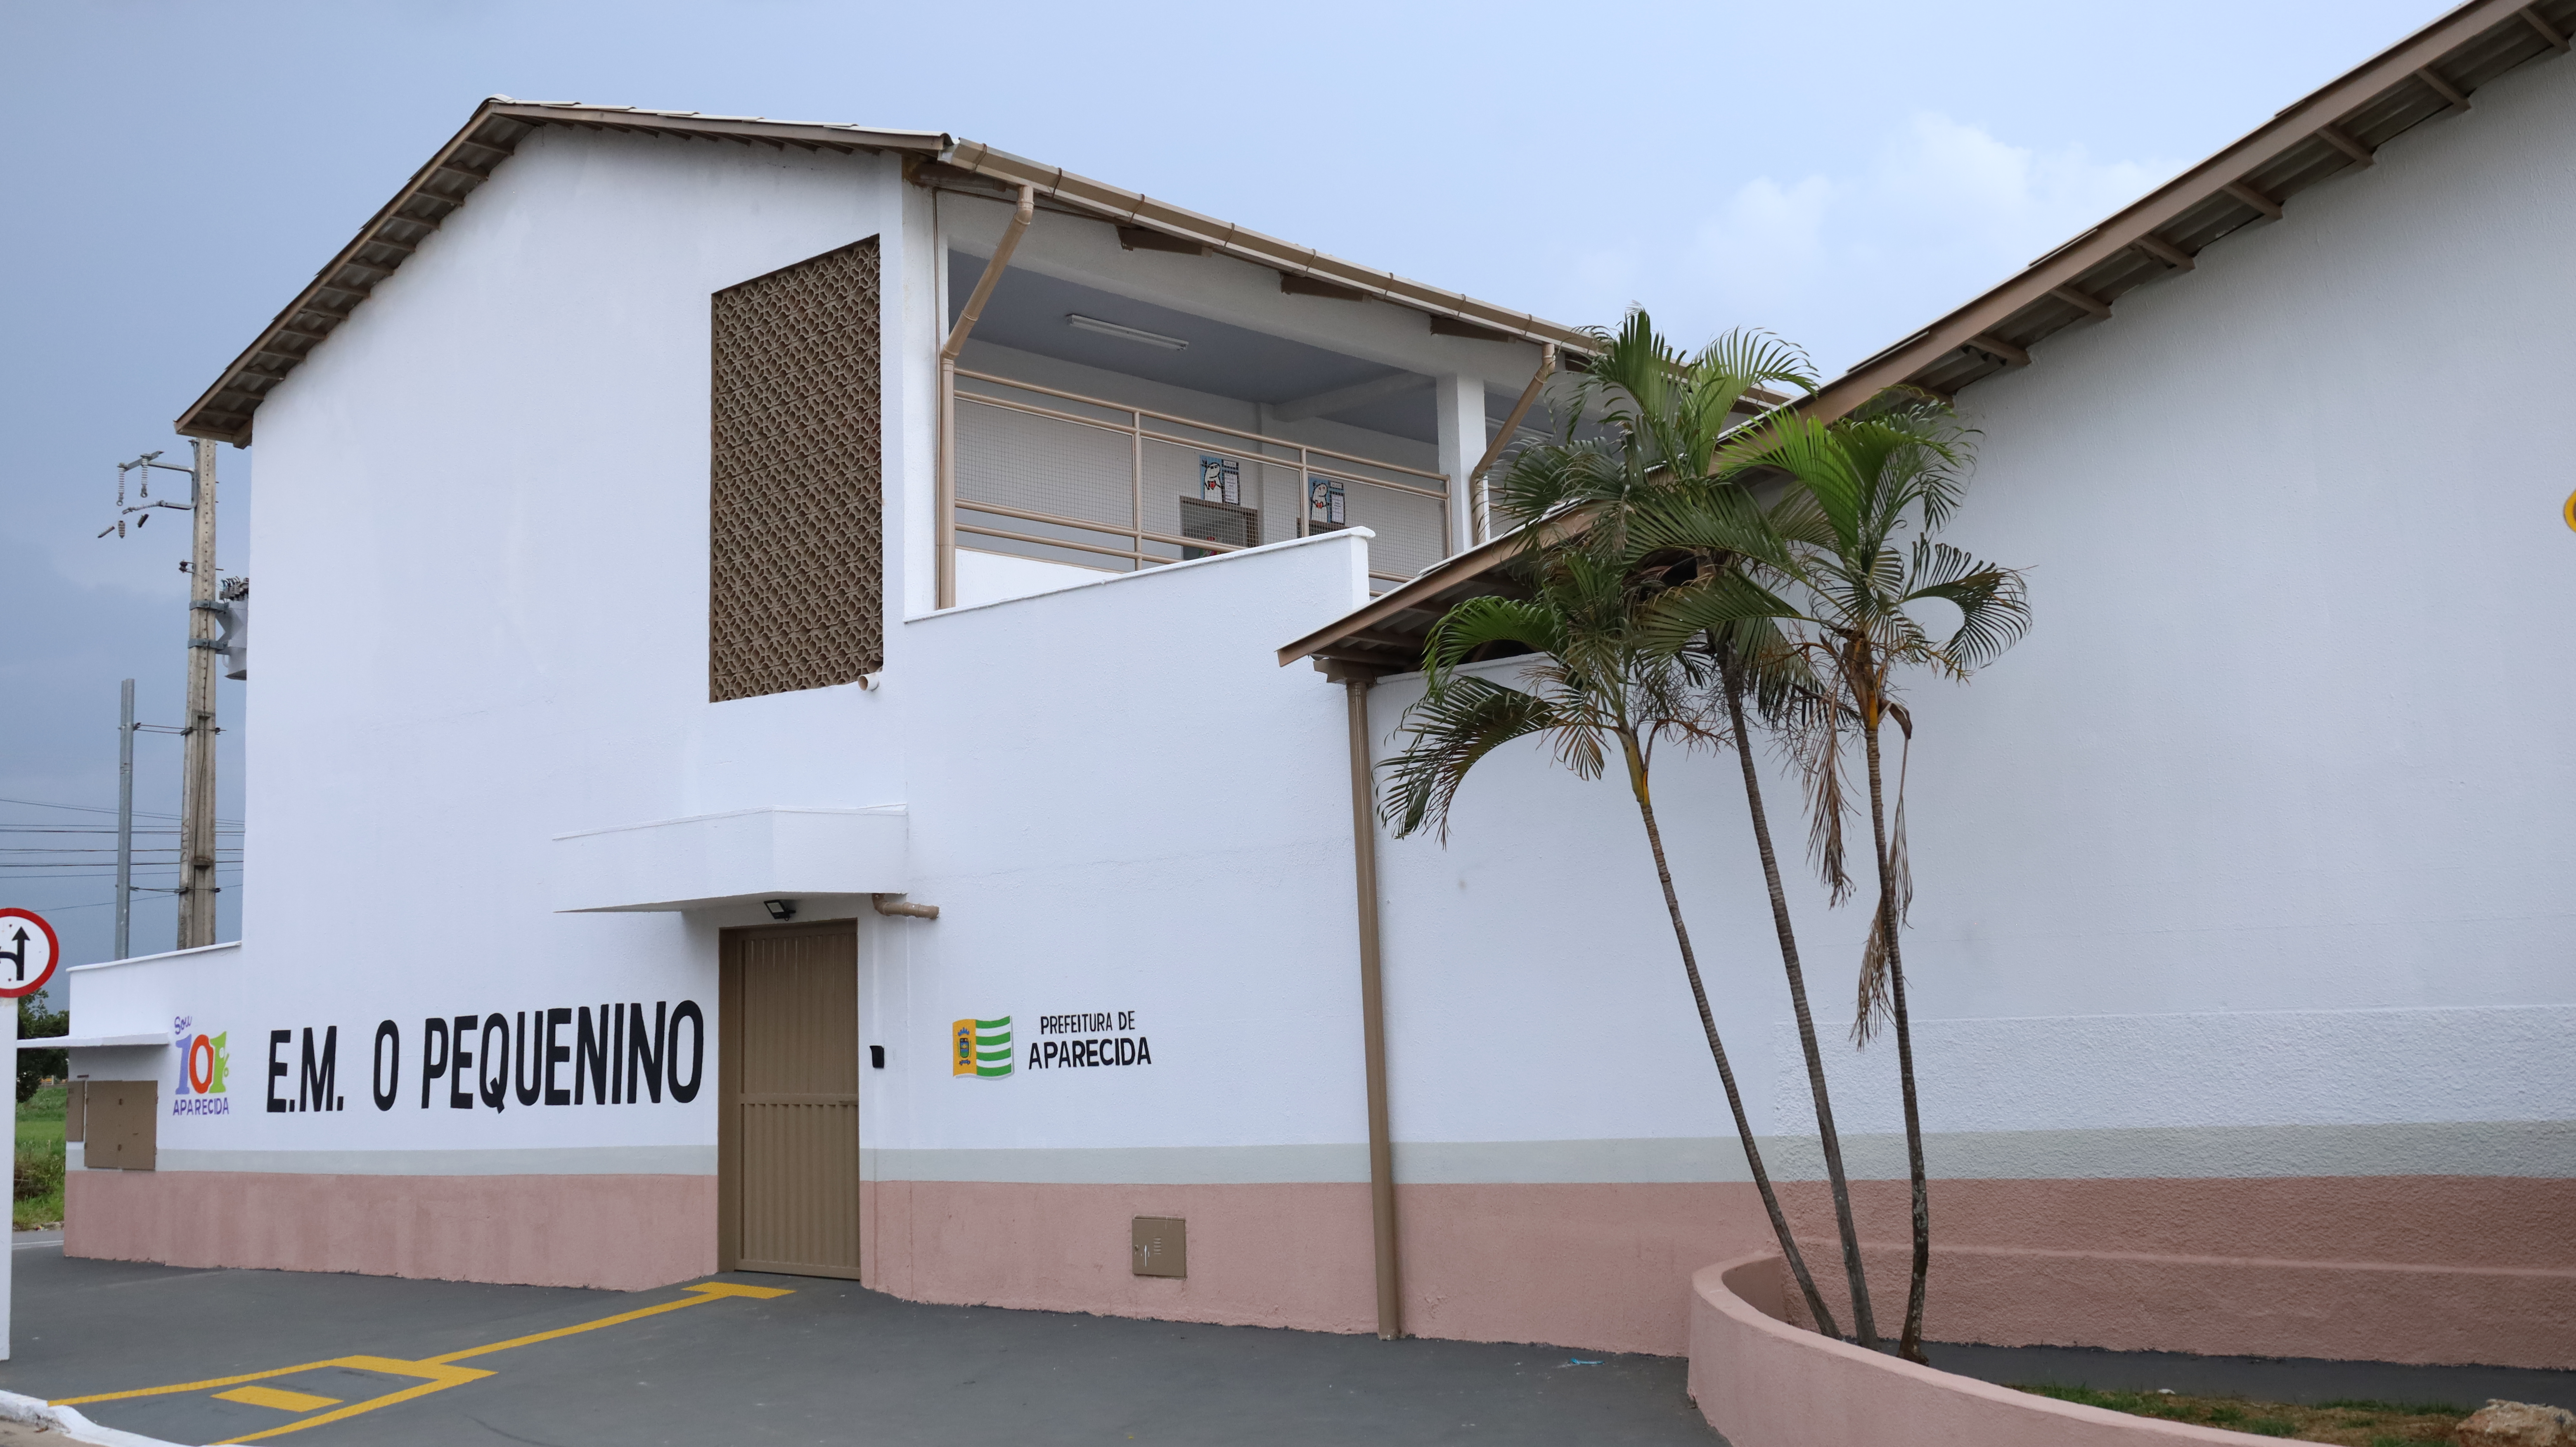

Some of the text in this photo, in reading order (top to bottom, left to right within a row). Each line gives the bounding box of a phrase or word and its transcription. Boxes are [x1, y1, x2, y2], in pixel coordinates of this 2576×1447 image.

[174, 1016, 192, 1035] Sou
[1040, 1011, 1135, 1035] PREFEITURA DE
[266, 999, 704, 1114] E.M. O PEQUENINO
[1028, 1037, 1152, 1070] APARECIDA
[173, 1097, 229, 1115] APARECIDA
